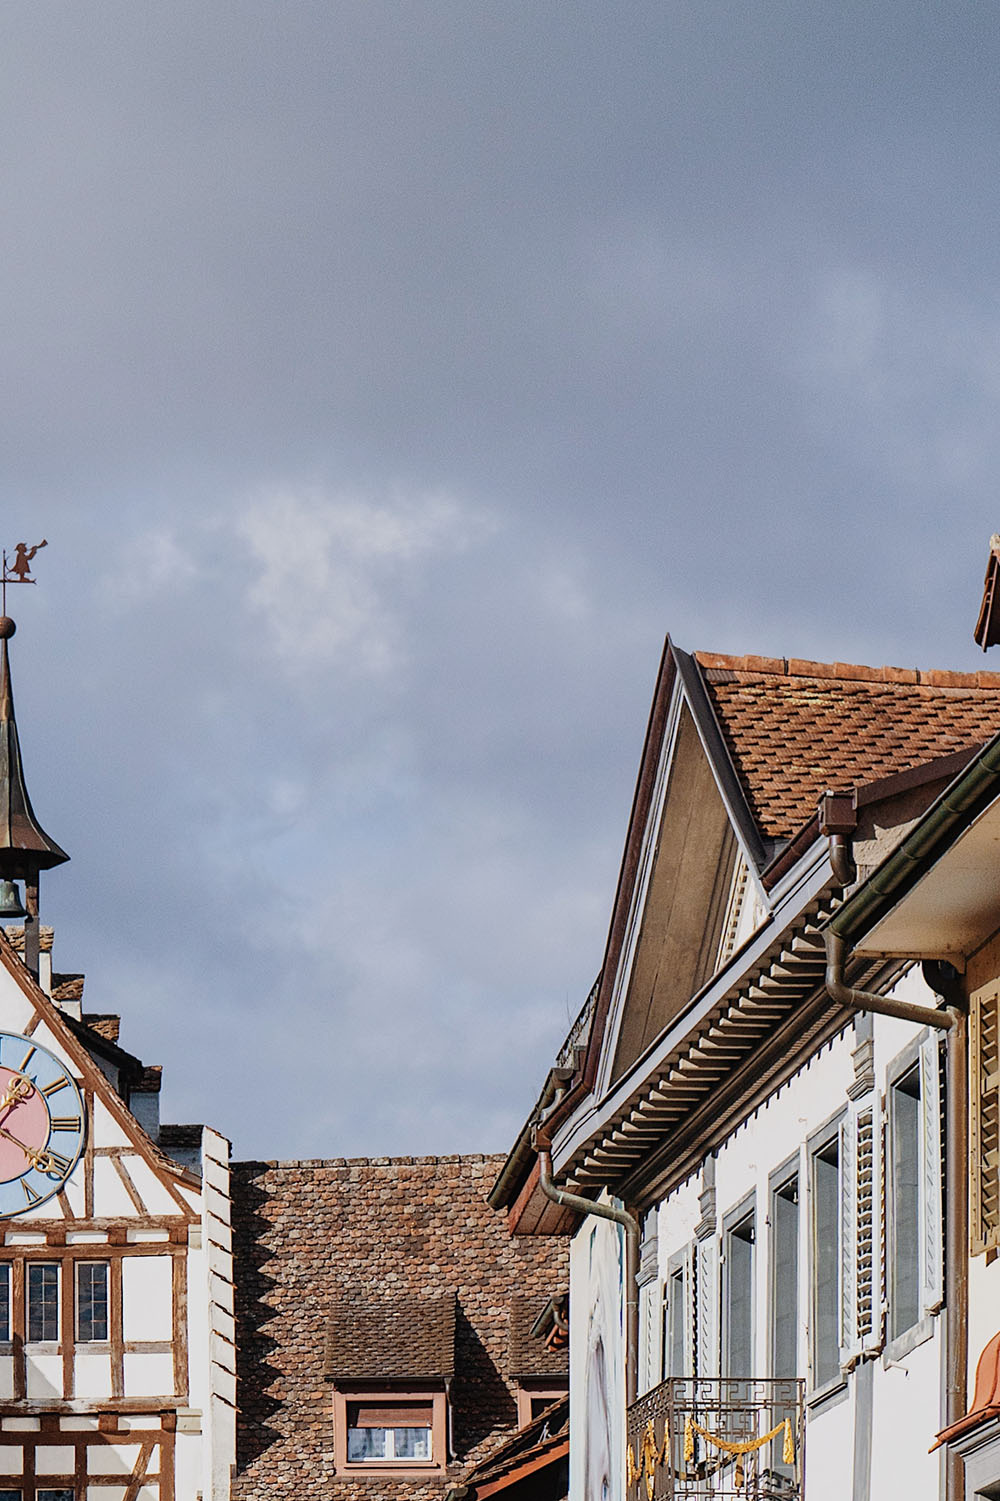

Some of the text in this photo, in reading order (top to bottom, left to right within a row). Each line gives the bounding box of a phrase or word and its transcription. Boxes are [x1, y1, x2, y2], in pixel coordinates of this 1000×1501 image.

[42, 1075, 70, 1097] II
[51, 1117, 81, 1133] III
[20, 1177, 42, 1205] V
